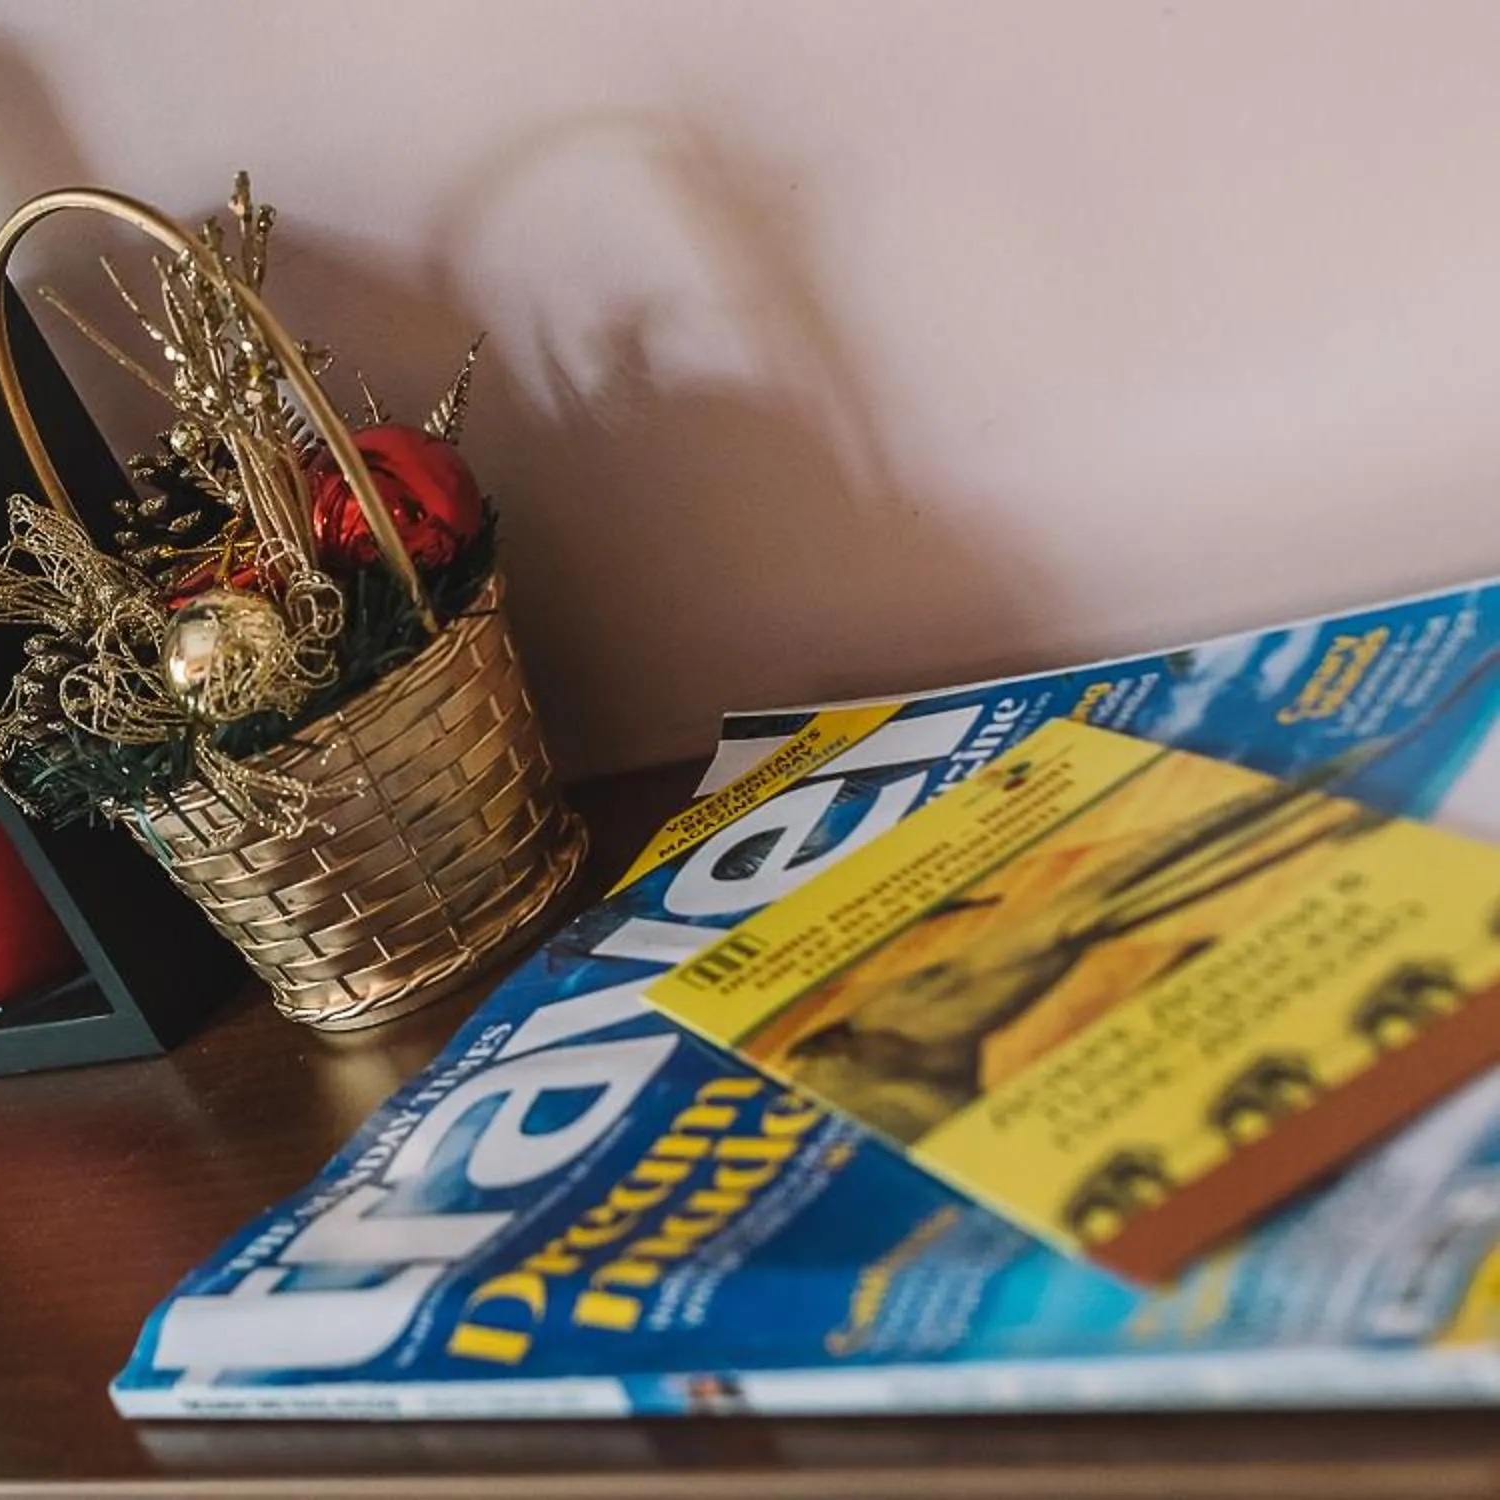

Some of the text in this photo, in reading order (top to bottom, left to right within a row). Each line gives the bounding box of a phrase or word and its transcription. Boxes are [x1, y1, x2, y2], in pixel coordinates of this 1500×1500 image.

[659, 791, 762, 859] MAGAZINE
[665, 728, 822, 833] VOTED BRITAIN'S
[723, 746, 815, 808] HOLIDAY
[152, 703, 986, 1390] travel
[222, 1022, 513, 1277] THE SUNDAY TIMES
[448, 1077, 765, 1365] Dream
[573, 1092, 822, 1332] made
